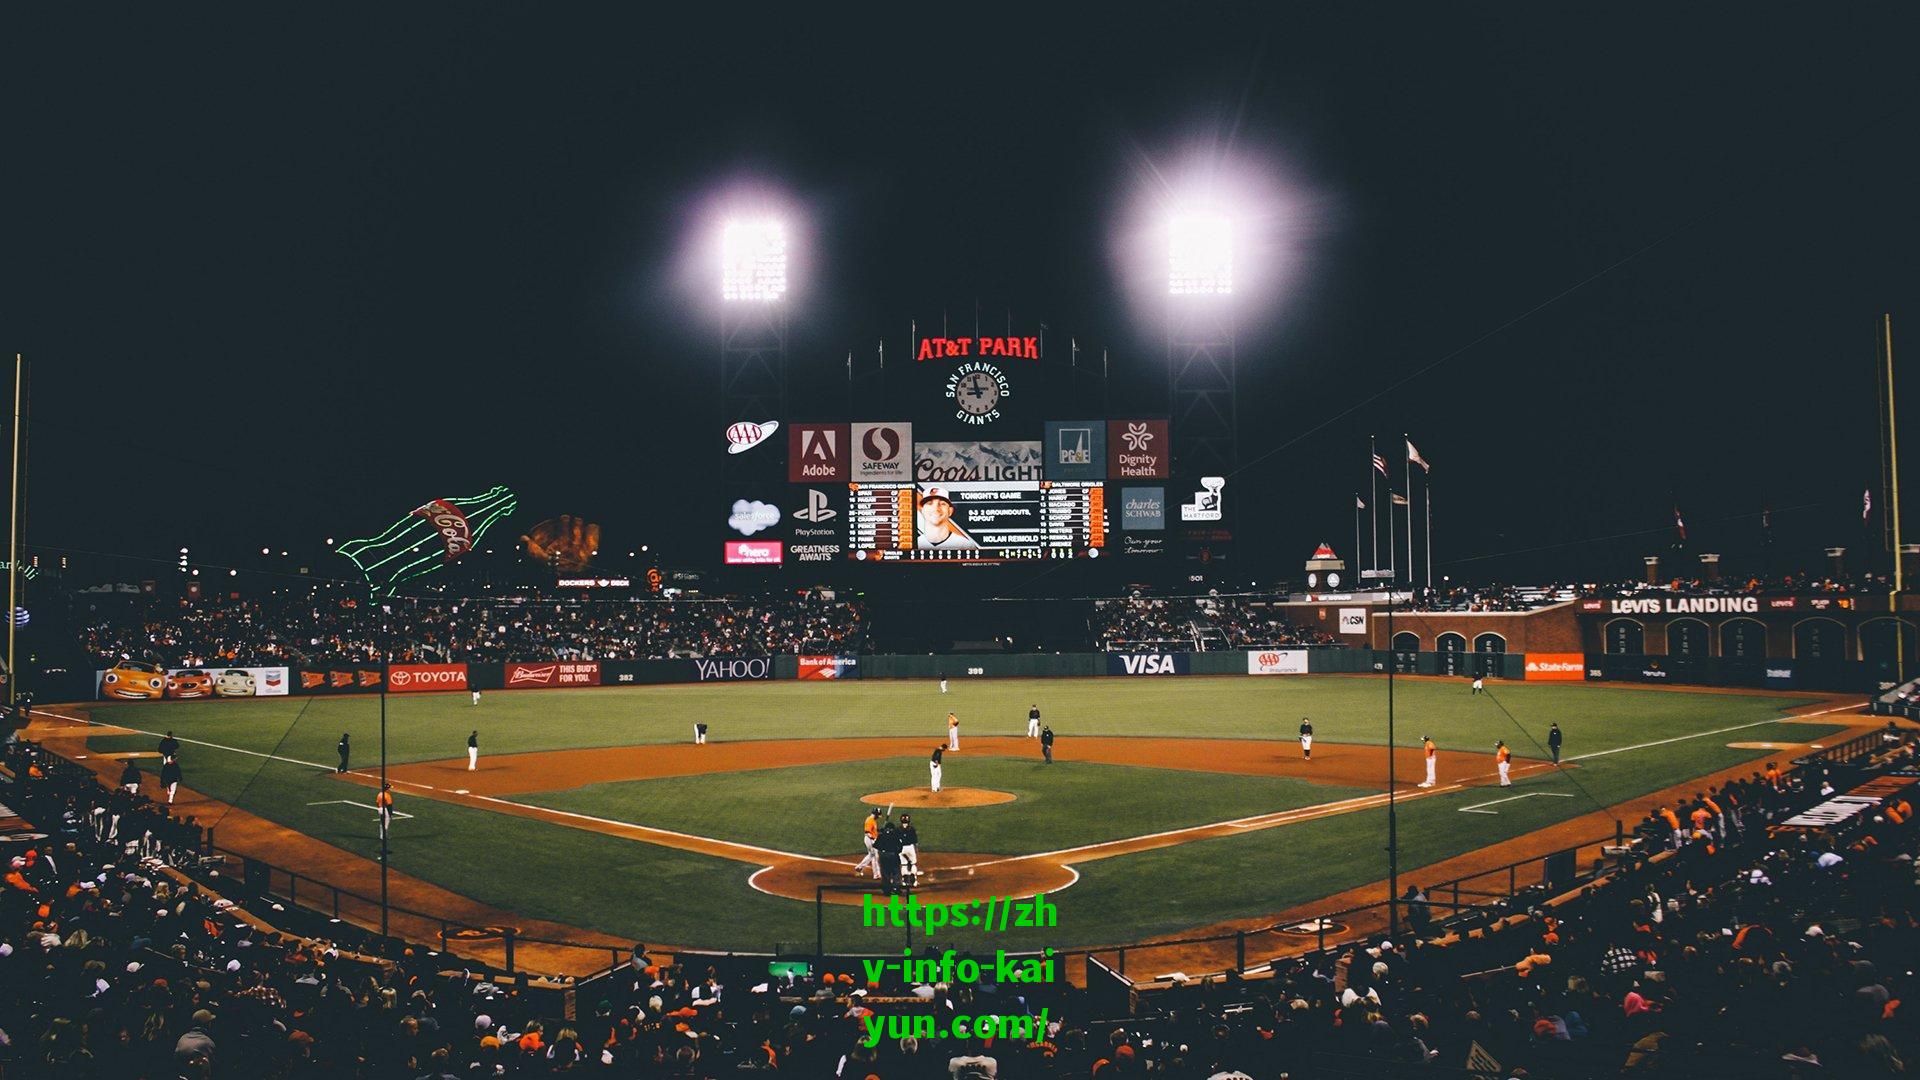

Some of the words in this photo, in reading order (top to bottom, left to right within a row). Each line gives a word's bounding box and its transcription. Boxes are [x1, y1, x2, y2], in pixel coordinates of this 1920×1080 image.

[918, 338, 972, 360] AT&T
[979, 336, 1038, 360] PARK
[946, 374, 960, 398] SAN
[958, 362, 1010, 397] FRANCISCO
[956, 409, 1000, 425] GIANTS
[1062, 450, 1089, 462] PG&E
[1119, 455, 1157, 466] Dignity
[802, 464, 835, 476] Adobe
[914, 458, 982, 481] Coors
[984, 466, 1042, 480] LIGHT
[1121, 467, 1156, 476] Health
[1126, 499, 1160, 509] charles
[735, 511, 774, 521] salesforce
[796, 529, 834, 537] PlayStation
[790, 545, 840, 553] GREATNESS
[799, 553, 832, 561] AWAITS
[1666, 597, 1758, 613] LANDING
[1350, 617, 1364, 625] CSN
[560, 665, 575, 673] THIS
[576, 664, 597, 672] BUD'S
[695, 658, 770, 680] YAHOO!
[1119, 655, 1175, 674] VISA
[413, 671, 466, 683] TOYOTA
[515, 670, 551, 679] Budweiser
[560, 674, 573, 682] FOR
[575, 674, 590, 682] YOU.
